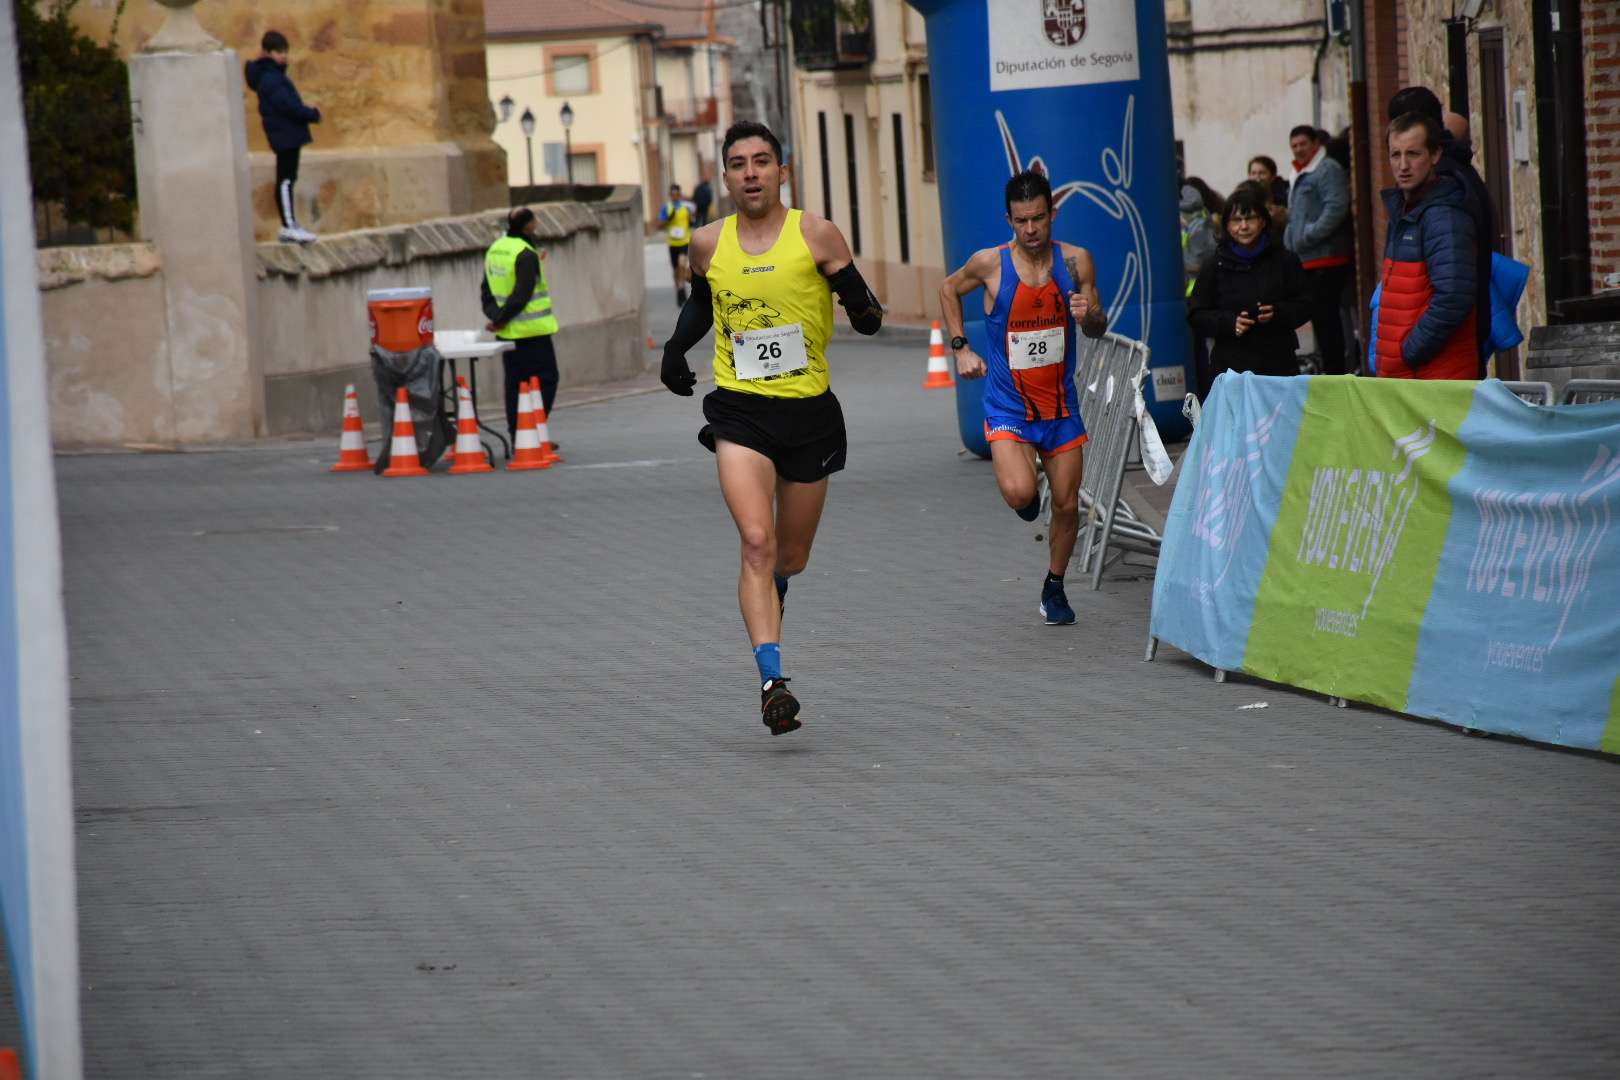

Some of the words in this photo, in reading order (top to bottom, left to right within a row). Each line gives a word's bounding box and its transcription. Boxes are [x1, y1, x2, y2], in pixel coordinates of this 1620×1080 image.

[996, 57, 1065, 75] Diputación
[1070, 54, 1087, 67] de
[1090, 52, 1134, 68] Segovia
[756, 341, 782, 361] 26
[1028, 341, 1047, 355] 28
